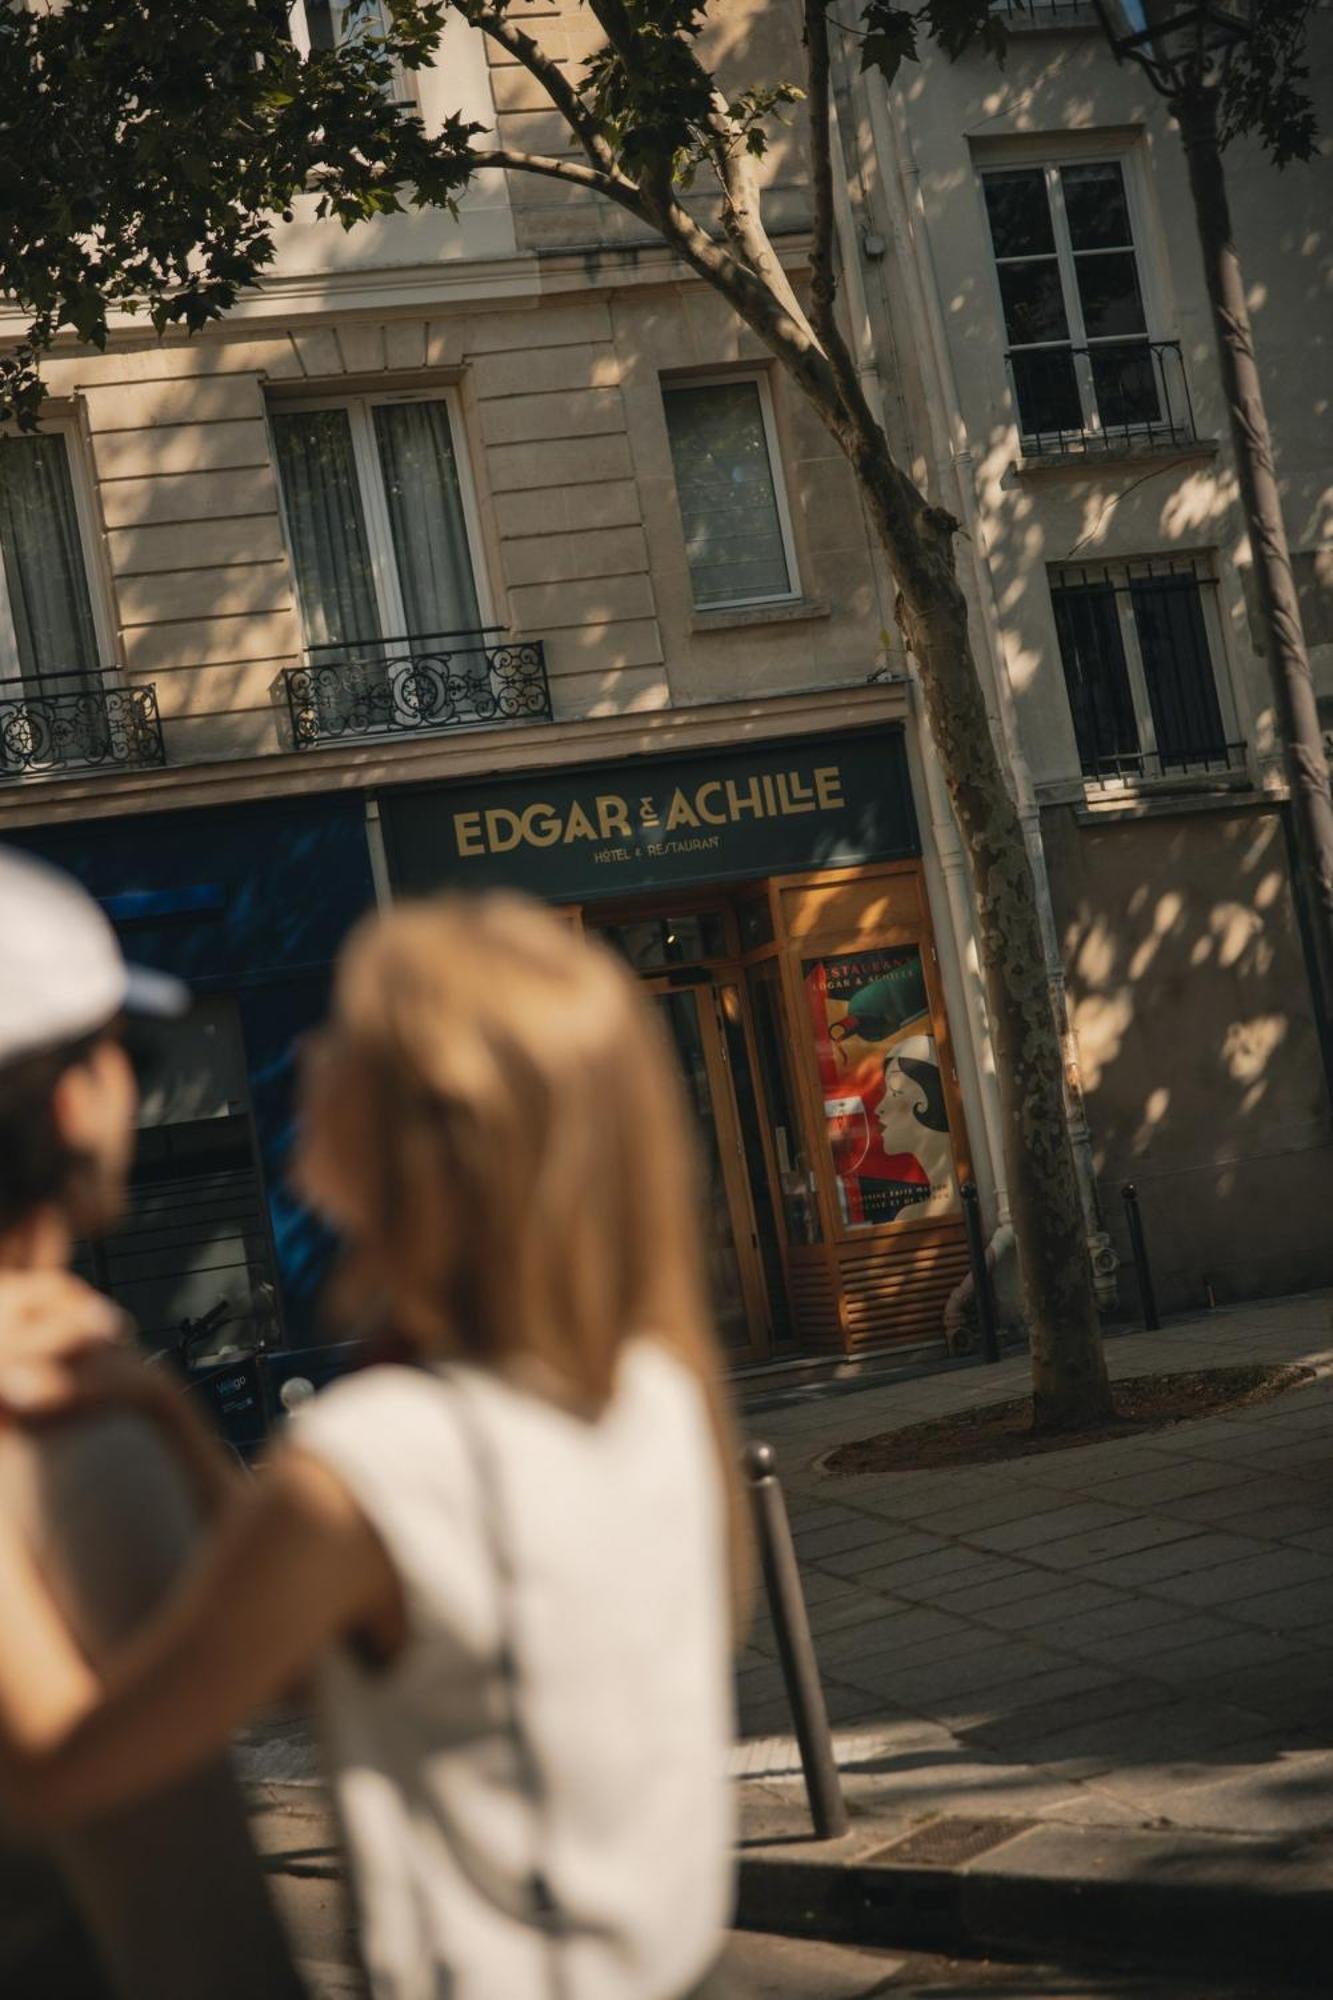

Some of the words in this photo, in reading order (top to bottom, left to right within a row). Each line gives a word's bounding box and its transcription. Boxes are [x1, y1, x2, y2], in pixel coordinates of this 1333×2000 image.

[453, 796, 632, 857] EDGAR
[639, 796, 660, 828] &
[666, 766, 846, 831] ACHILLE
